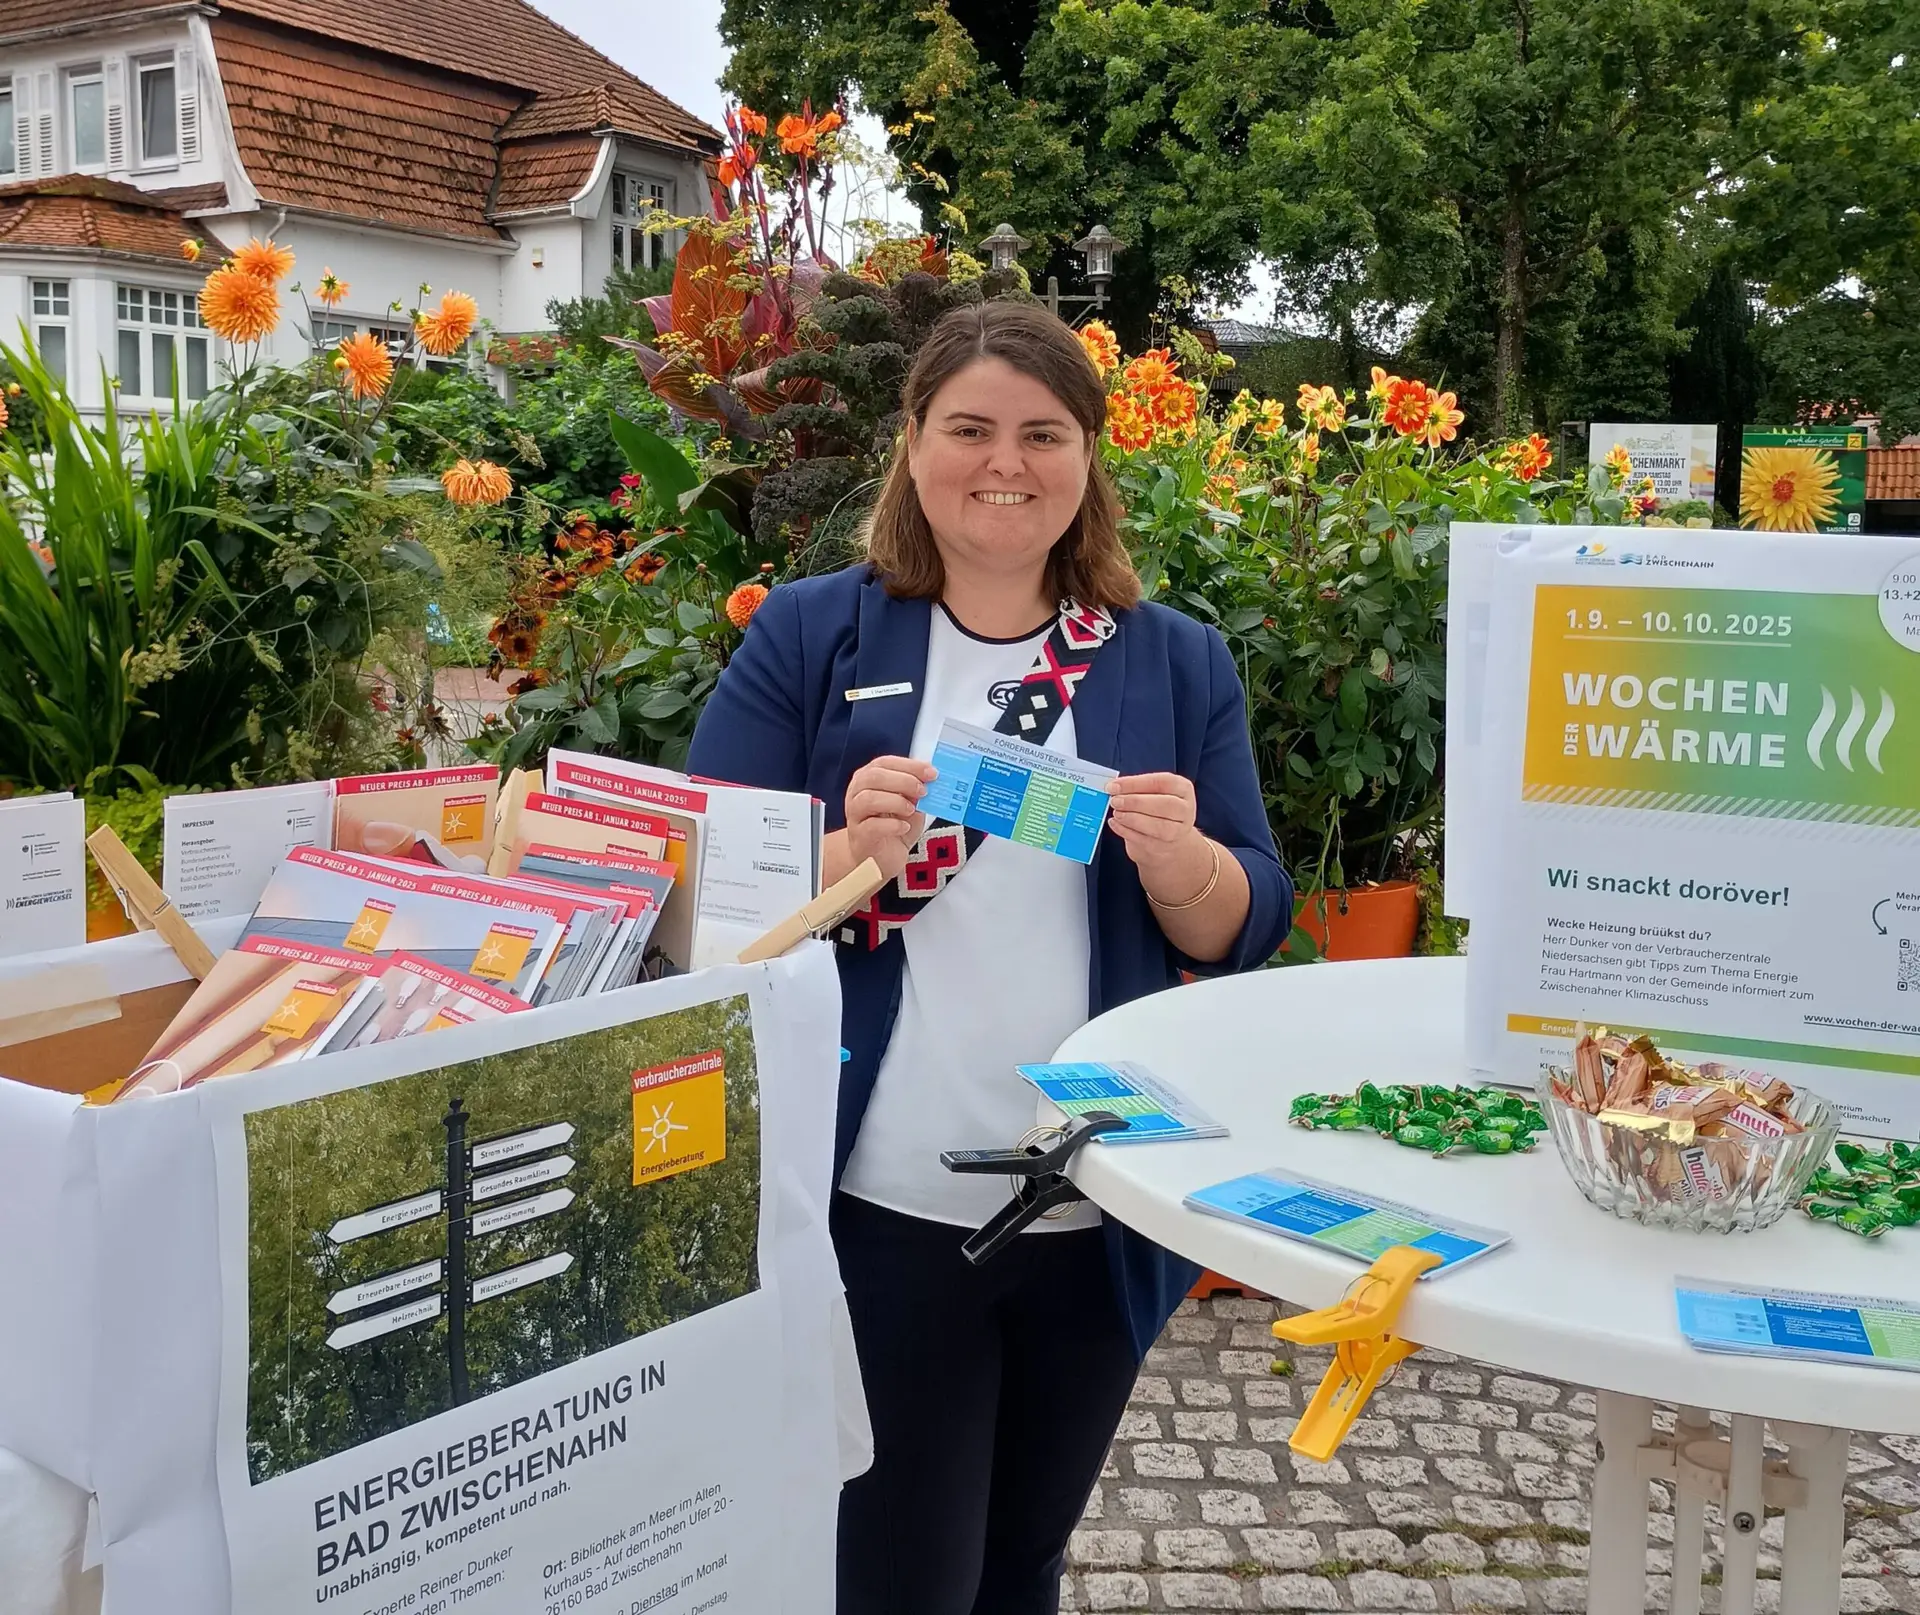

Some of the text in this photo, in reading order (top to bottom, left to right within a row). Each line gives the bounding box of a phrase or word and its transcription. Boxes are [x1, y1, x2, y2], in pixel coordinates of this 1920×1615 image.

[1631, 457, 1686, 469] CHENMARKT
[1645, 559, 1714, 568] ZWISCHENAHN
[1892, 574, 1916, 584] 9.00
[1563, 672, 1789, 716] WOCHEN
[994, 737, 1067, 767] FÖRDERBAUSTEINE
[1563, 720, 1786, 768] DER WÄRME
[968, 741, 1018, 763] Zwischenahner
[1019, 757, 1068, 778] Klimazuschuss
[1068, 772, 1085, 783] 2025
[360, 781, 386, 792] NEUER
[388, 779, 411, 790] PREIS
[412, 778, 423, 787] AB
[433, 775, 461, 787] JANUAR
[570, 771, 688, 805] NEUER PREIS AB 1. JANUAR 2025!
[182, 819, 215, 829] IMPRESSUM
[541, 801, 651, 832] NEUER PREIS AB 1. JANUAR 2025!
[300, 852, 322, 865] NEUER
[322, 858, 346, 871] PREIS
[346, 864, 358, 874] AB
[359, 868, 366, 877] 1.
[366, 870, 399, 885] JANUAR
[15, 893, 73, 909] ENERGIEWECHSEL
[430, 882, 456, 894] NEUER
[456, 888, 480, 900] PREIS
[480, 894, 491, 903] AB
[492, 897, 500, 906] 1.
[501, 899, 532, 913] JANUAR
[1548, 868, 1790, 906] Wi snackt doröver!
[1547, 917, 1712, 941] Wecke Heizung brüükst du?
[256, 943, 280, 955] NEUER
[280, 947, 301, 958] PREIS
[301, 950, 312, 960] AB
[312, 953, 319, 962] 1.
[319, 954, 349, 968] JANUAR
[1542, 934, 1771, 965] Herr Dunker von der Verbraucherzentrale
[400, 960, 422, 973] NEUER
[421, 968, 442, 981] PREIS
[441, 974, 453, 986] AB
[458, 983, 490, 1001] JANUAR
[1541, 949, 1799, 984] Niedersachsen gibt Tipps zum Thema Energie
[1539, 980, 1709, 1006] Zwischenahner Klimazuschuss
[1540, 965, 1814, 1001] Frau Hartmann von der Gemeinde informiert zum
[633, 1053, 722, 1089] verbraucherzentrale
[1731, 1107, 1781, 1138] anuta
[480, 1142, 525, 1160] Strom sparen
[640, 1150, 705, 1177] Energieberatung
[480, 1169, 550, 1194] Gesundes Raumklima
[381, 1202, 434, 1225] Energie sparen
[357, 1271, 433, 1302] Erneuerbare Energien
[480, 1276, 519, 1295] Hitzeschutz
[392, 1304, 434, 1325] Heiztechnik
[314, 1360, 667, 1532] ENERGIEBERATUNG IN
[317, 1416, 627, 1577] BAD ZWISCHENAHN
[316, 1480, 571, 1604] Unabhängig, kompetent und nah.
[543, 1483, 722, 1579] Ort: Bibliothek am Meer im Alten
[544, 1497, 727, 1600] Kurhaus Auf dem hohen Ufer 20
[419, 1569, 464, 1600] Reiner
[467, 1545, 514, 1577] Dunker
[450, 1570, 505, 1604] Themen:
[545, 1541, 683, 1615] 26160 Bad Zwischenahn
[631, 1553, 728, 1615] Dienstag im Monat
